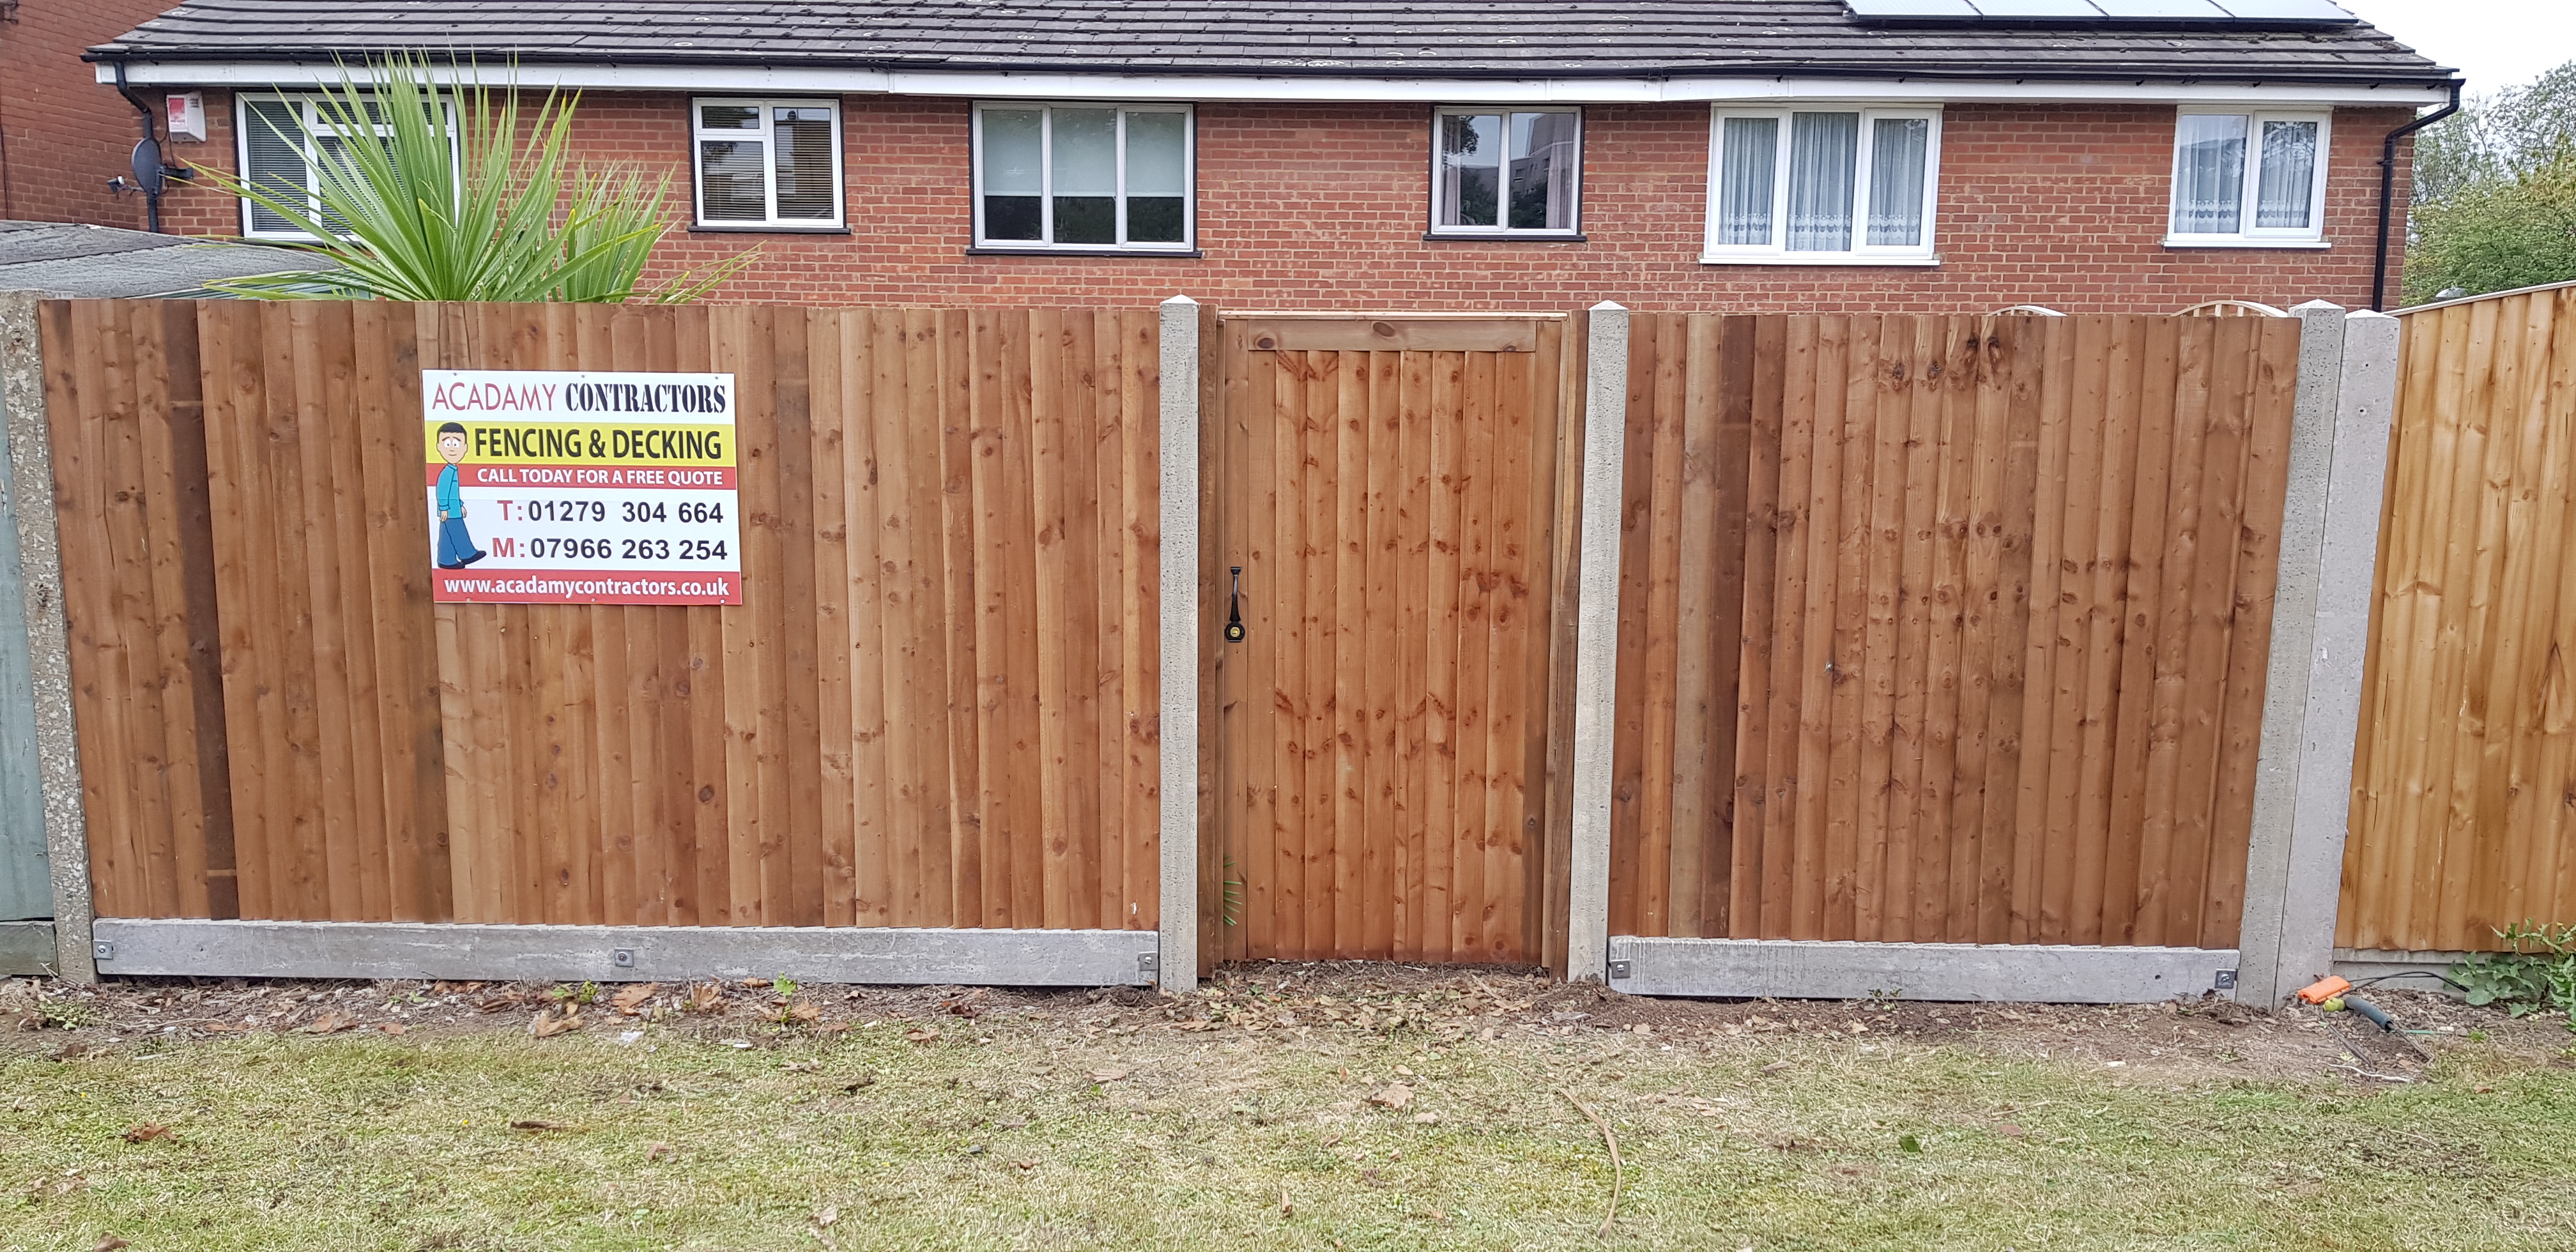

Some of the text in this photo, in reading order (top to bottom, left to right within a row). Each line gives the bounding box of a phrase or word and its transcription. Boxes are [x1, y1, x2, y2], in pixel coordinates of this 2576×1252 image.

[433, 383, 725, 413] ACADAMY CONTRACTORS
[475, 429, 721, 459] FENCING & DECKING
[478, 469, 723, 486] CALL TODAY FOR A FREE QUOTE
[622, 501, 666, 522] 304
[678, 503, 723, 523] 664
[622, 539, 670, 559] 263
[679, 540, 727, 560] 254
[445, 576, 729, 597] www.acadamycontractors.co.uk
